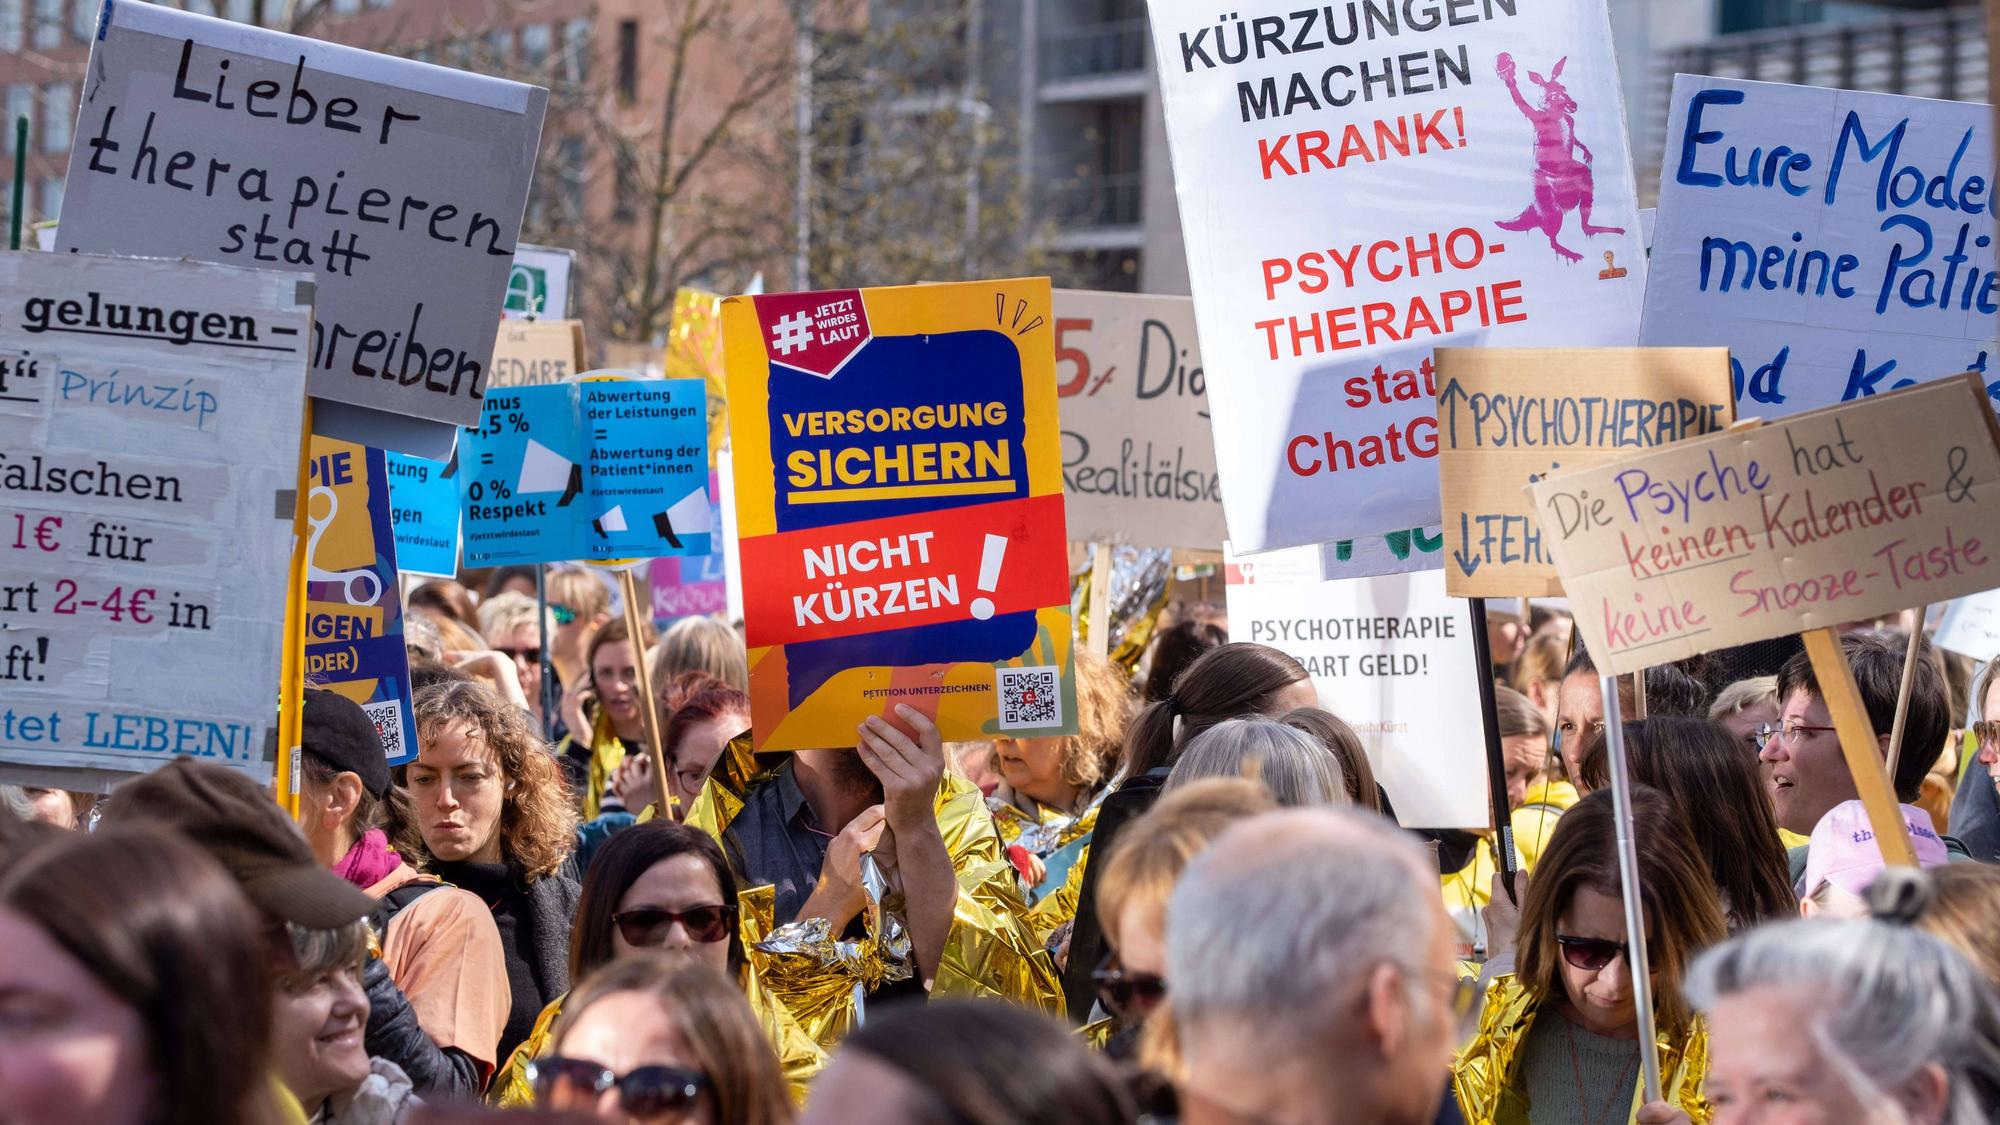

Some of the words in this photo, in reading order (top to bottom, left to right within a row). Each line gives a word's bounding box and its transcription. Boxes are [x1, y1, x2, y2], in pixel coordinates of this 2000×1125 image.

[1179, 0, 1518, 73] KÜRZUNGEN
[173, 39, 420, 144] Lieber
[1236, 44, 1472, 122] MACHEN
[1257, 105, 1467, 180] KRANK!
[1676, 89, 1812, 196] Eure
[89, 106, 515, 255] therapieren
[220, 214, 370, 276] statt
[1262, 227, 1505, 300] PSYCHO-
[1700, 231, 1859, 298] meine
[24, 292, 258, 345] gelungen
[814, 298, 854, 319] JETZT
[816, 313, 858, 329] WIRDES
[1254, 280, 1528, 360] THERAPIE
[820, 325, 861, 346] LAUT
[60, 369, 218, 431] Prinzip
[588, 390, 671, 404] Abwertung
[588, 407, 612, 420] der
[616, 405, 697, 420] Leistungen
[783, 401, 1007, 437] VERSORGUNG
[1470, 391, 1724, 448] PSYCHOTHERAPIE
[590, 447, 673, 461] Abwertung
[677, 445, 701, 458] der
[786, 439, 1011, 488] SICHERN
[1548, 490, 1613, 540] Die
[1615, 450, 1771, 523] Psyche
[1785, 417, 1863, 477] hat
[469, 481, 483, 502] 0
[490, 479, 510, 499] %
[470, 499, 547, 526] Respekt
[1620, 518, 1755, 578] keinen
[1760, 470, 1927, 550] Kalender
[1944, 445, 1977, 504] &
[12, 513, 62, 552] 1€
[87, 522, 153, 562] für
[803, 531, 934, 580] NICHT
[53, 579, 156, 624] 2-4€
[168, 592, 211, 630] in
[793, 574, 960, 627] KÜRZEN
[1603, 593, 1707, 651] keine
[1730, 526, 1990, 618] Snooze-Taste
[1251, 616, 1456, 641] PSYCHOTHERAPIE
[863, 687, 907, 699] PETITION
[908, 684, 992, 697] UNTERZEICHNEN:
[1359, 654, 1428, 677] GELD!
[83, 711, 250, 760] LEBEN!
